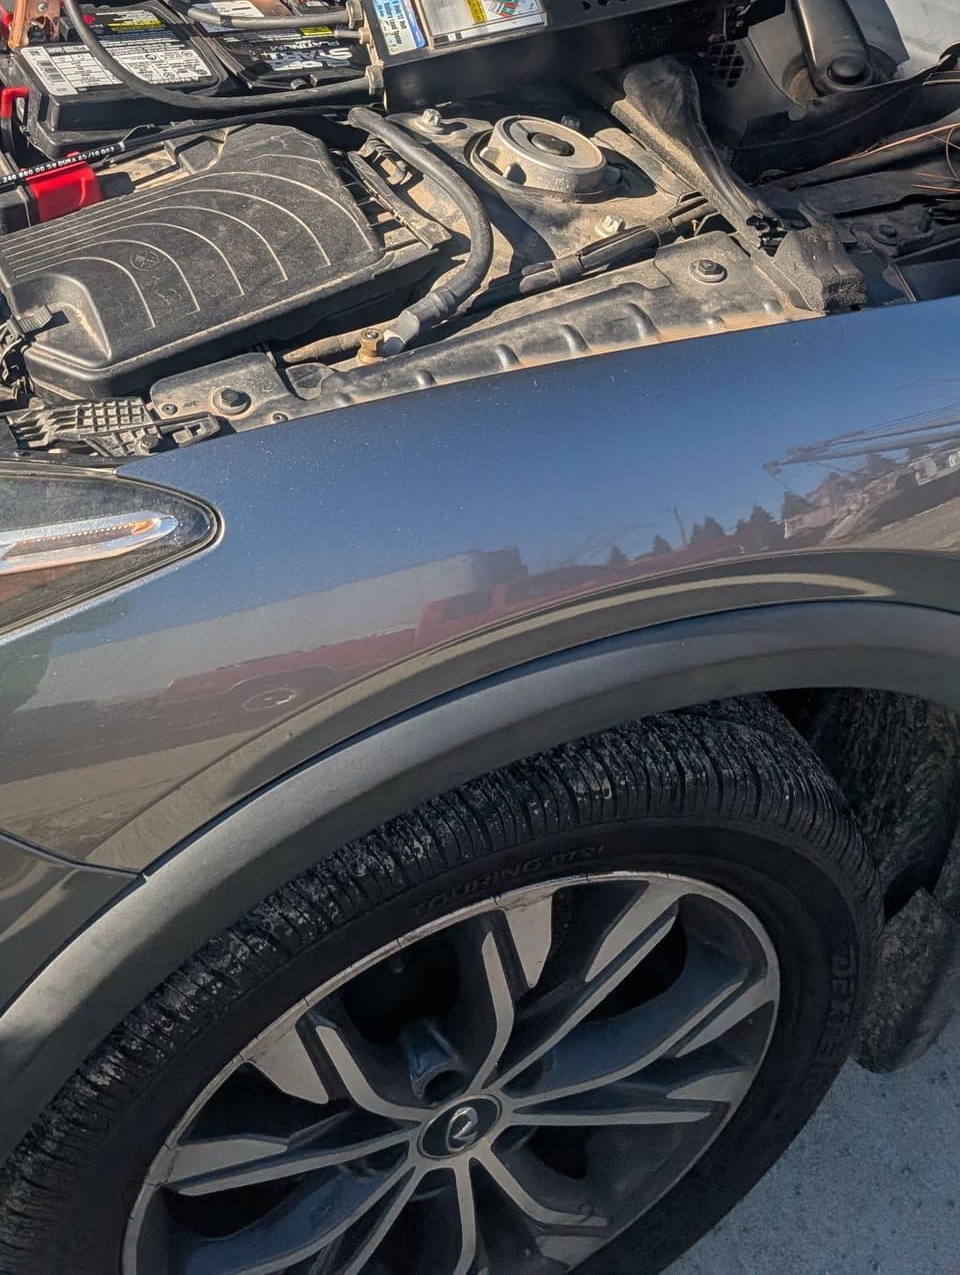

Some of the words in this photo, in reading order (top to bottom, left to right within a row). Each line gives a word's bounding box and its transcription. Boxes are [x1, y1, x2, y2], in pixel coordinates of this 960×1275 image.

[270, 40, 340, 51] PLATINUM
[263, 47, 353, 63] START
[411, 858, 543, 914] TOURING
